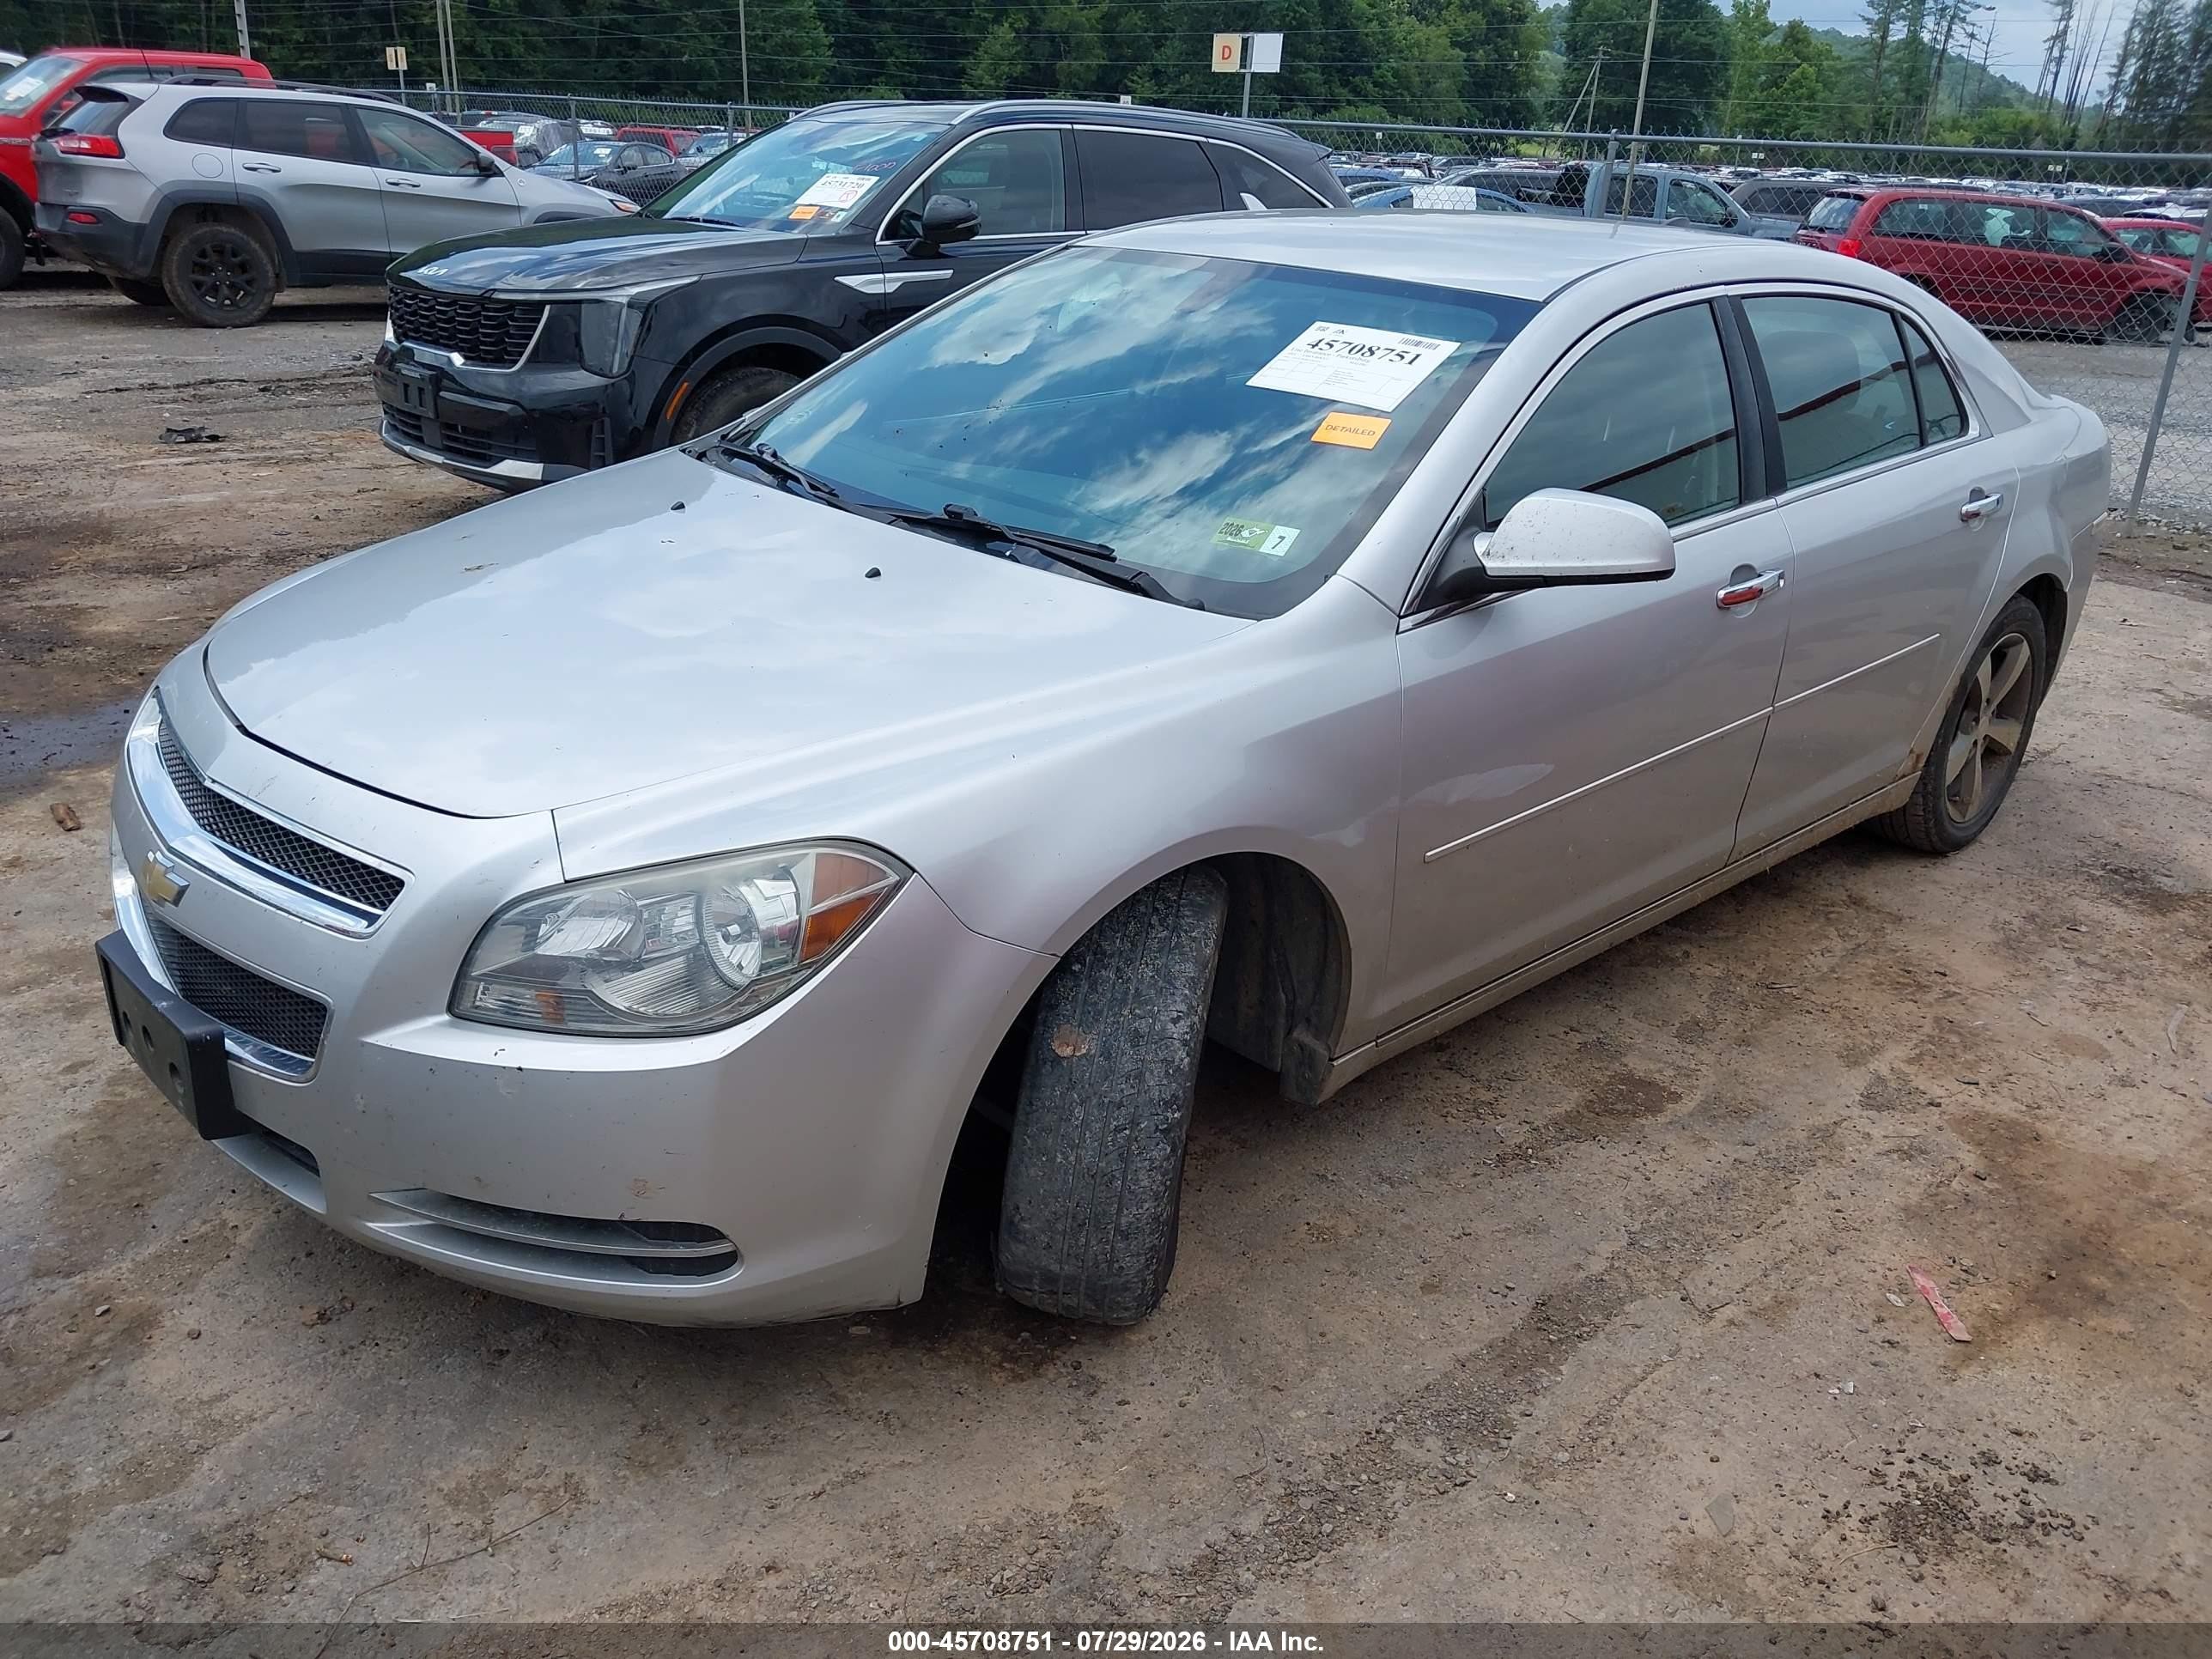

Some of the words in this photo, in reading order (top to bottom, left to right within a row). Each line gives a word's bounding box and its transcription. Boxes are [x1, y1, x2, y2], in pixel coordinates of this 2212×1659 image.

[1222, 46, 1231, 60] D
[1306, 337, 1422, 365] 45708751
[1325, 424, 1376, 436] DETAILED
[1218, 522, 1244, 537] 2026
[1272, 535, 1286, 550] 7
